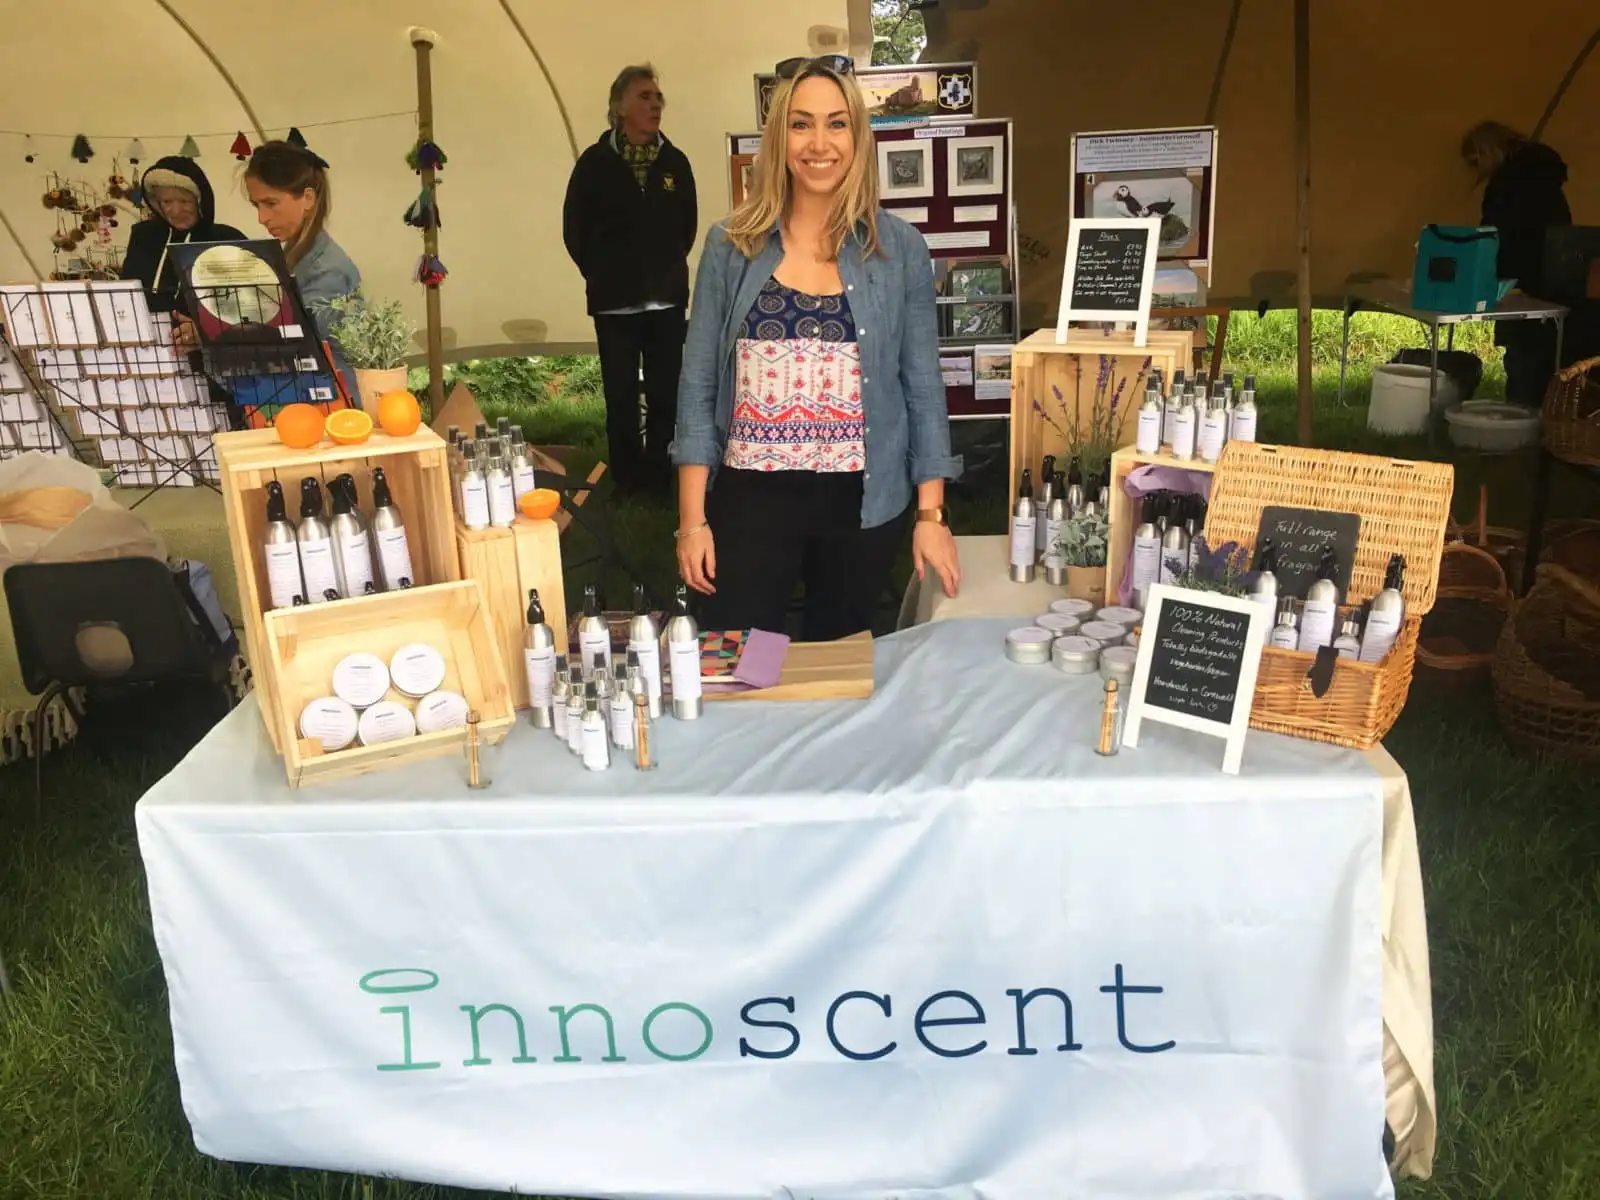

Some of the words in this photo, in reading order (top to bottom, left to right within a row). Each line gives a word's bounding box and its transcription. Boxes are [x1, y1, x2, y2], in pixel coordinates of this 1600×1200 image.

[1274, 520, 1300, 534] Full
[1301, 526, 1338, 545] range
[1279, 540, 1293, 549] in
[1298, 543, 1321, 553] all
[1169, 605, 1204, 623] 100%
[1205, 613, 1243, 632] Natural
[1171, 623, 1205, 642] Cleaning
[1206, 631, 1244, 650] Products
[359, 963, 1176, 1072] innoscent
